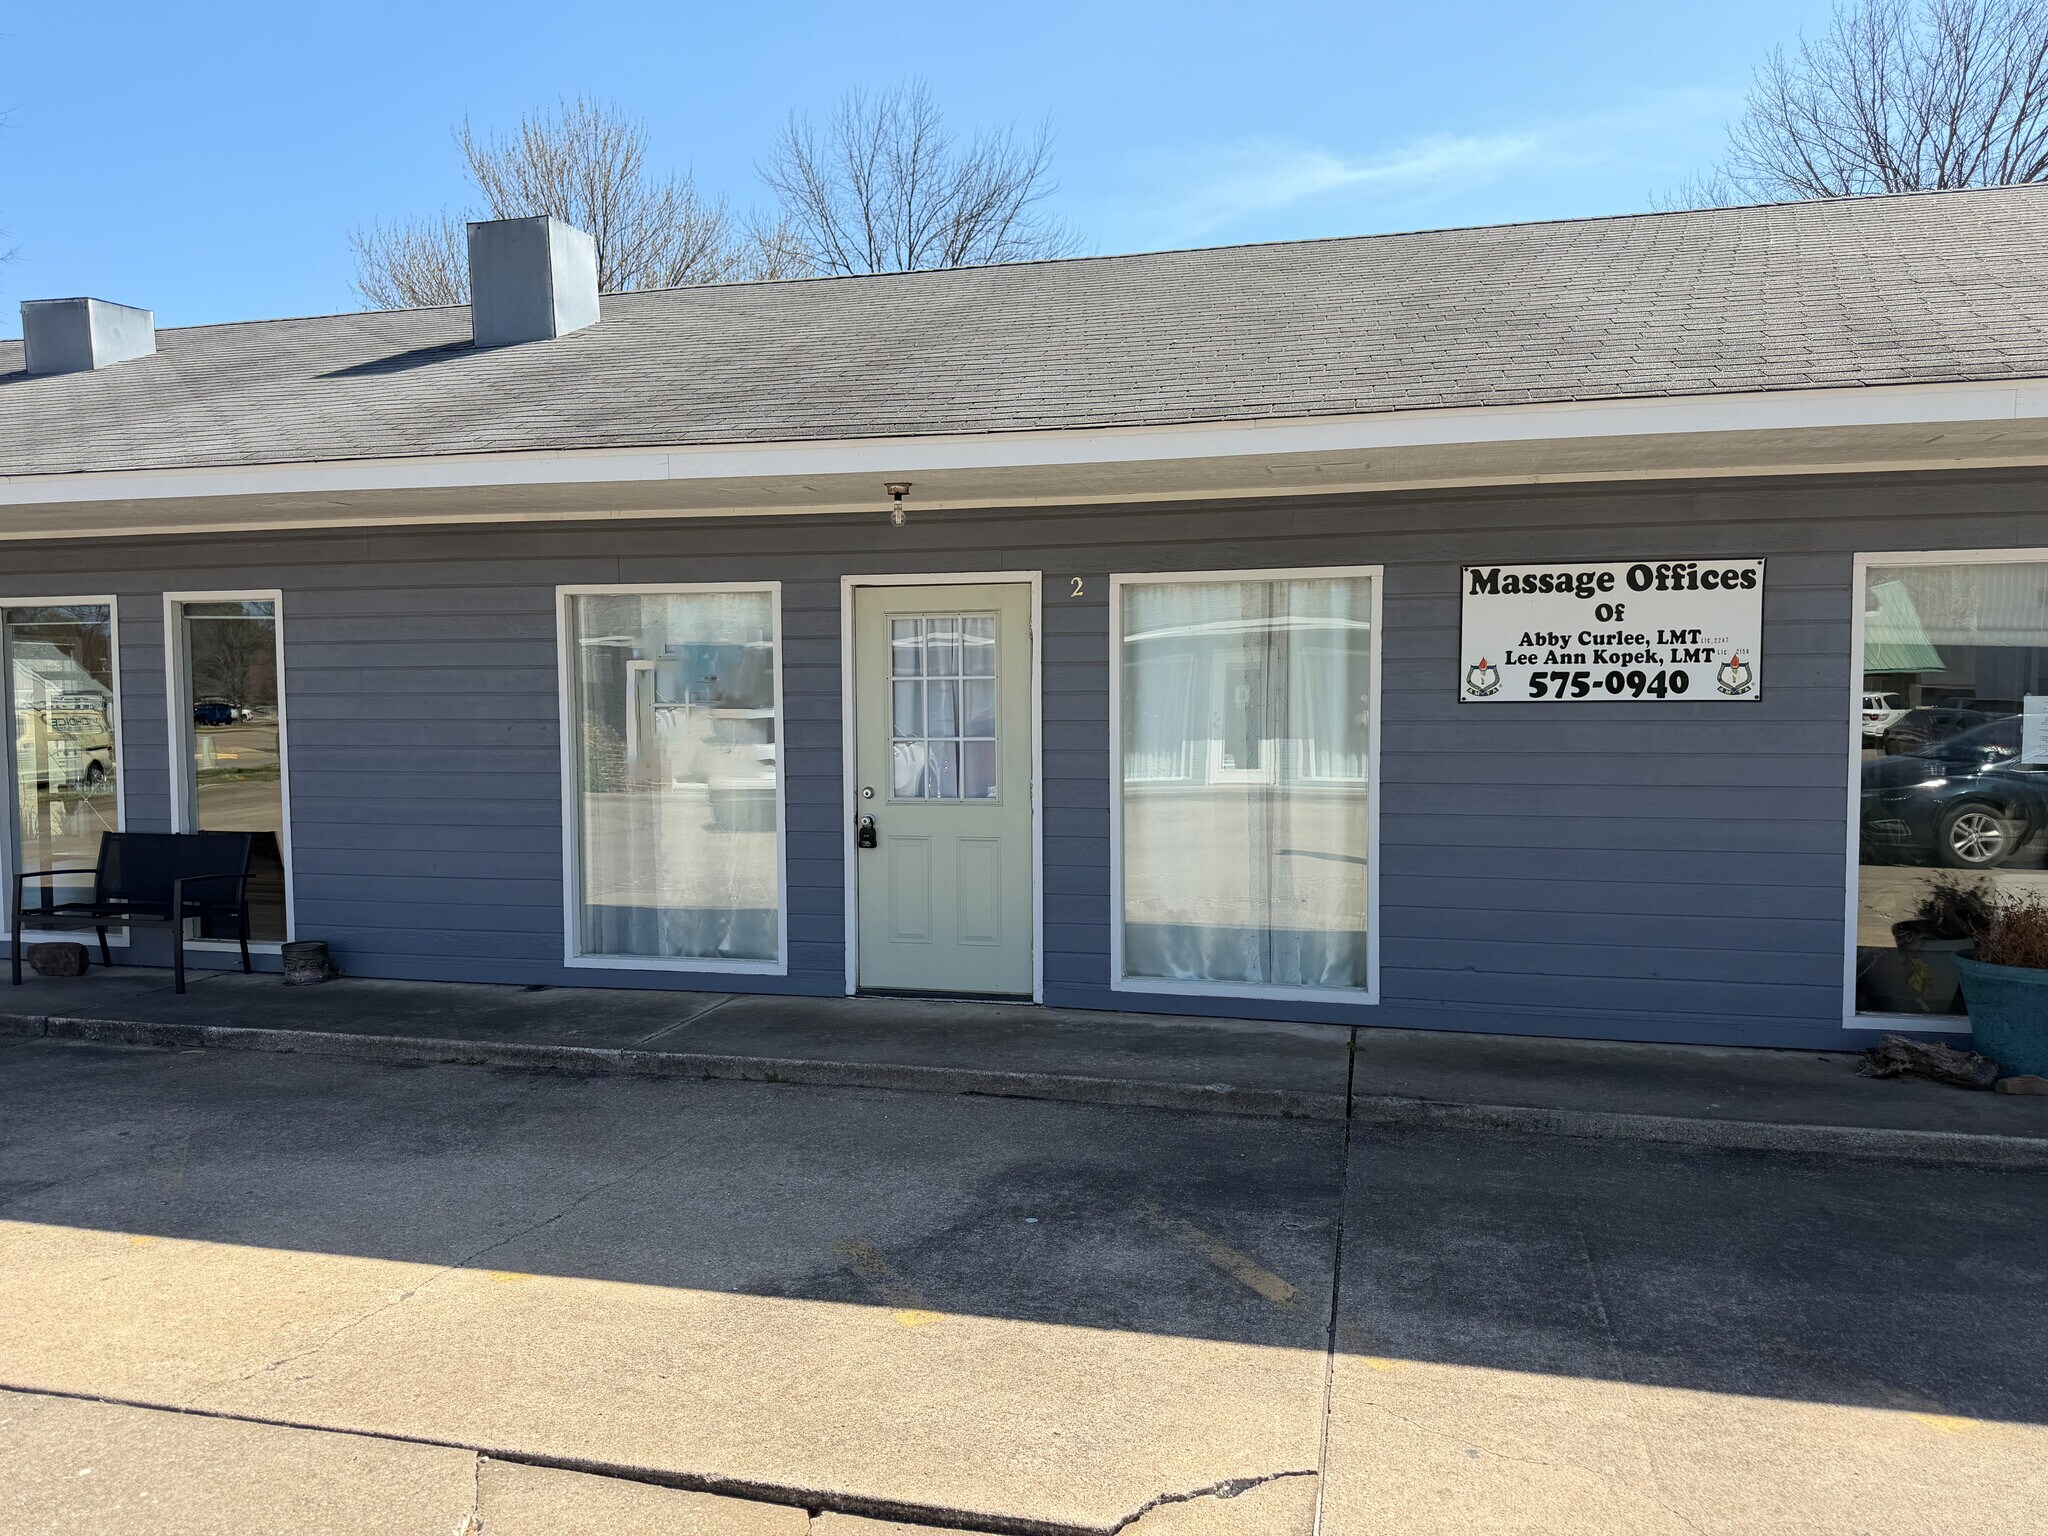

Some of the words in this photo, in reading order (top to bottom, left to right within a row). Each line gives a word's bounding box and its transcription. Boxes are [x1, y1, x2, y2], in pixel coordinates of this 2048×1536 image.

[1070, 576, 1084, 597] 2
[1469, 567, 1615, 600] Massage
[1626, 562, 1757, 592] Offices
[1594, 603, 1626, 622] Of
[1518, 631, 1573, 649] Abby
[1577, 630, 1651, 649] Curlee,
[1657, 629, 1702, 645] LMT
[1505, 651, 1538, 666] Lee
[1544, 649, 1587, 665] Ann
[1592, 648, 1664, 668] Kopek,
[1670, 647, 1716, 663] LMT
[1529, 669, 1690, 698] 575-0940
